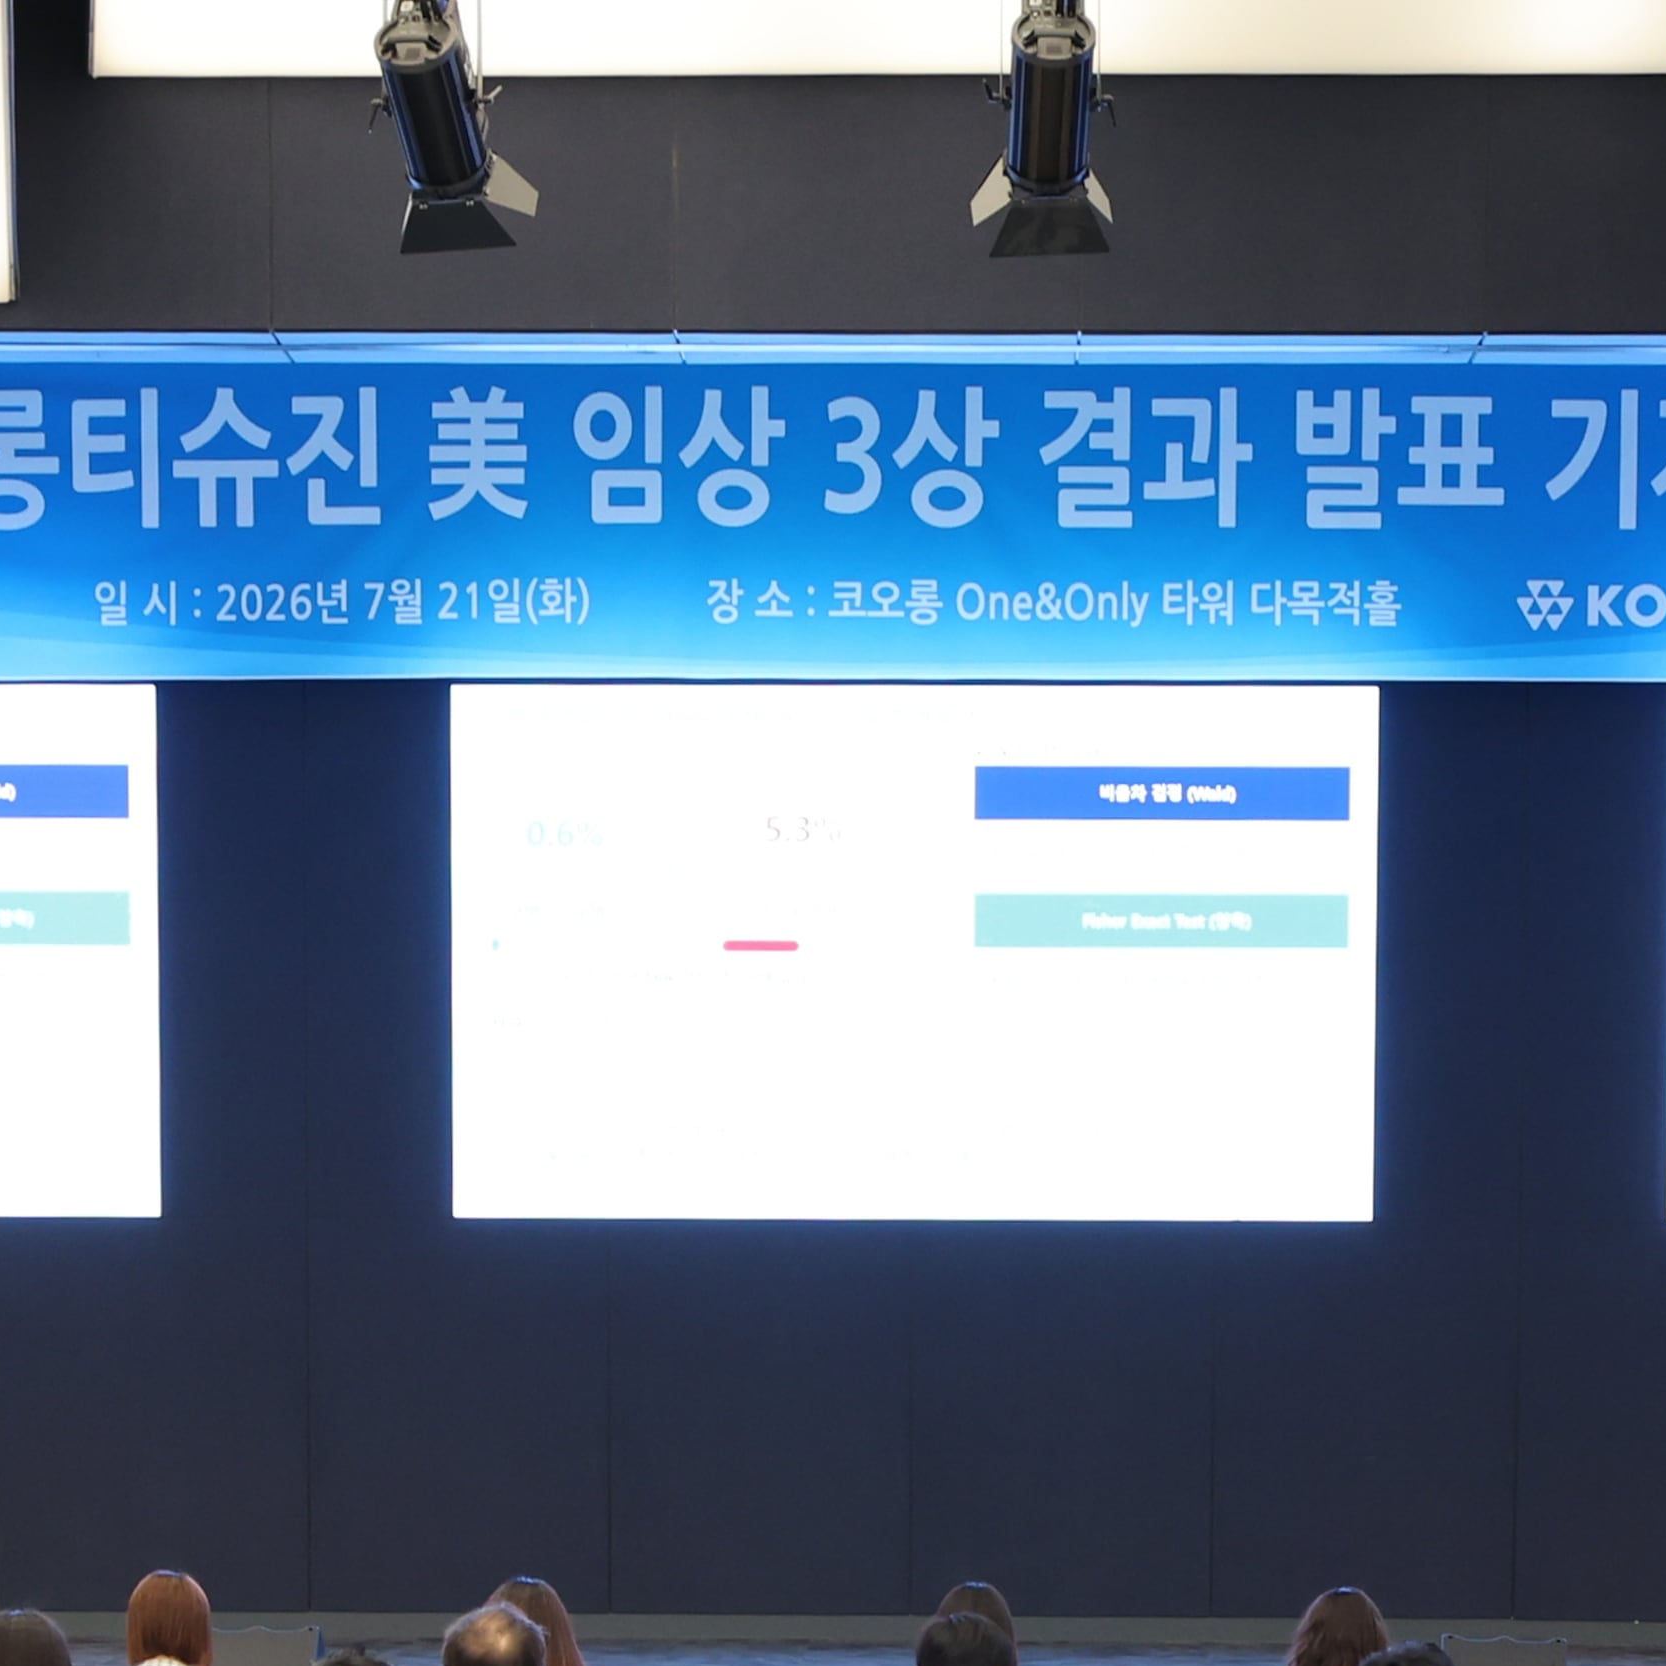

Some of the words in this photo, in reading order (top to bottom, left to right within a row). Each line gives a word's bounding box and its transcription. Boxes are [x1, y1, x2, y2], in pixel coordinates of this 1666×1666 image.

[428, 386, 528, 521] 美
[574, 386, 785, 527] 임상
[824, 386, 999, 528] 3상
[1040, 387, 1253, 529] 결과
[1296, 388, 1504, 530] 발표
[95, 580, 127, 626] 일
[143, 580, 177, 626] 시
[216, 579, 349, 625] 2026년
[364, 578, 423, 625] 7월
[438, 577, 589, 625] 21일(화)
[707, 578, 745, 625] 장
[755, 580, 793, 617] 소
[829, 579, 943, 626] 코오롱
[956, 580, 1149, 628] One&Only
[1163, 579, 1234, 626] 타워
[1251, 580, 1402, 627] 다목적홀
